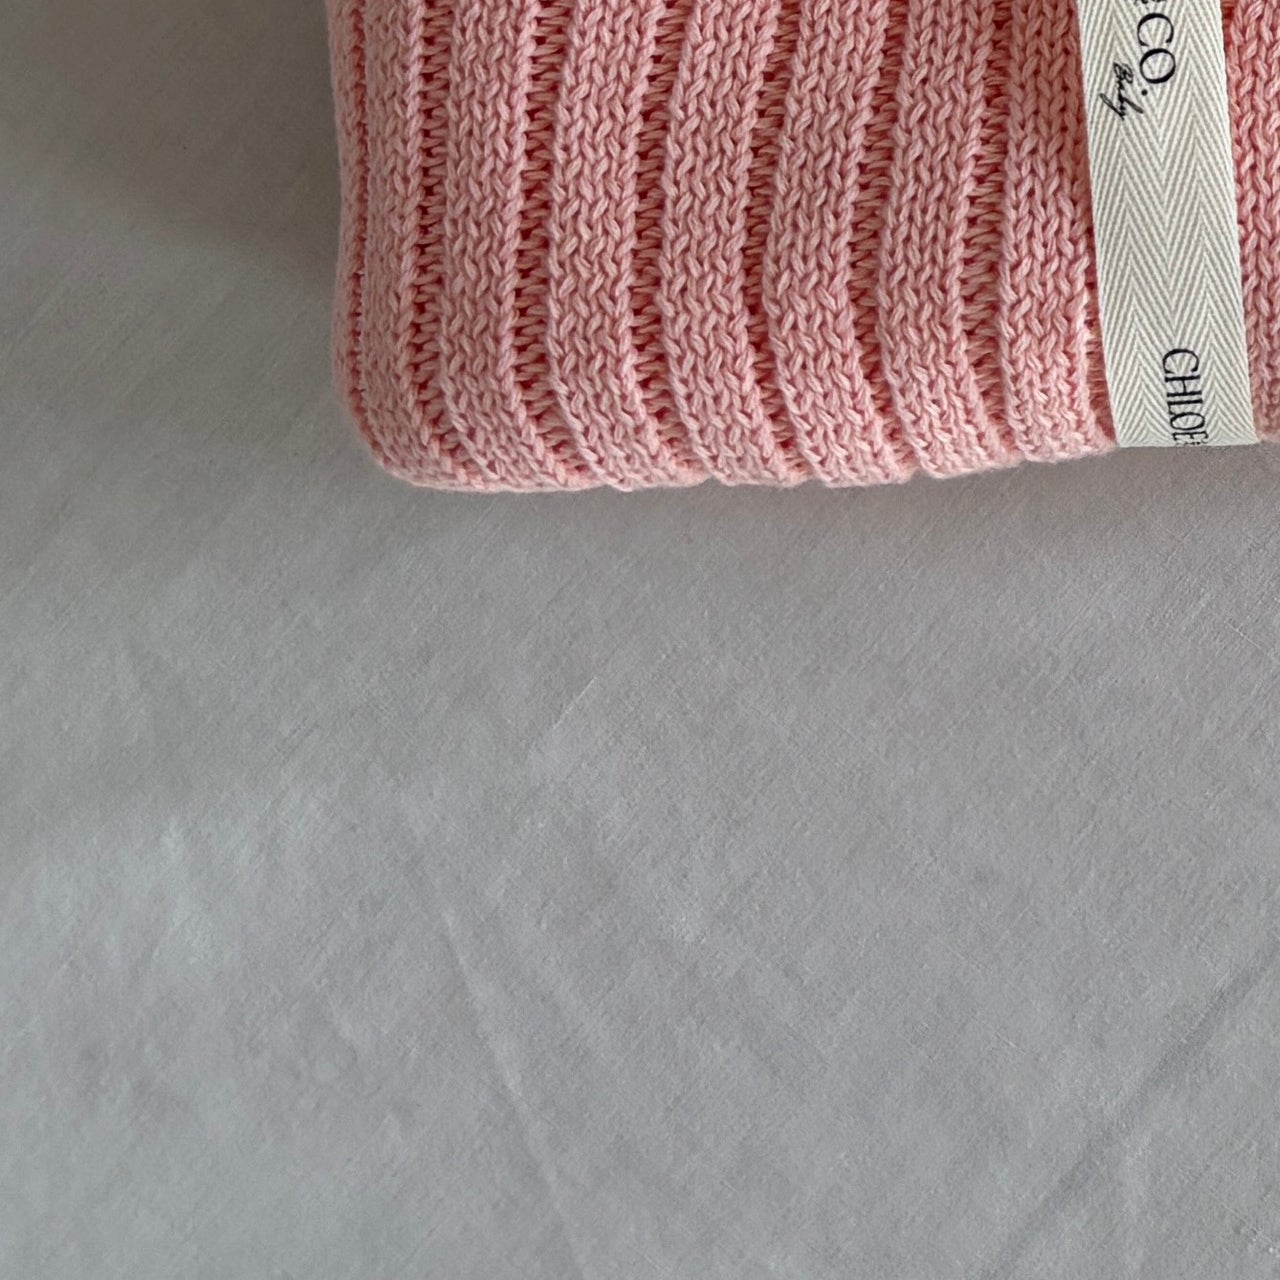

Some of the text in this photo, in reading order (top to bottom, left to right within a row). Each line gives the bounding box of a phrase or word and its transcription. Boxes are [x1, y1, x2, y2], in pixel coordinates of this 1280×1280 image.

[1100, 62, 1144, 121] Baby
[1136, 13, 1176, 96] CO.
[1162, 348, 1209, 442] CHLOE
